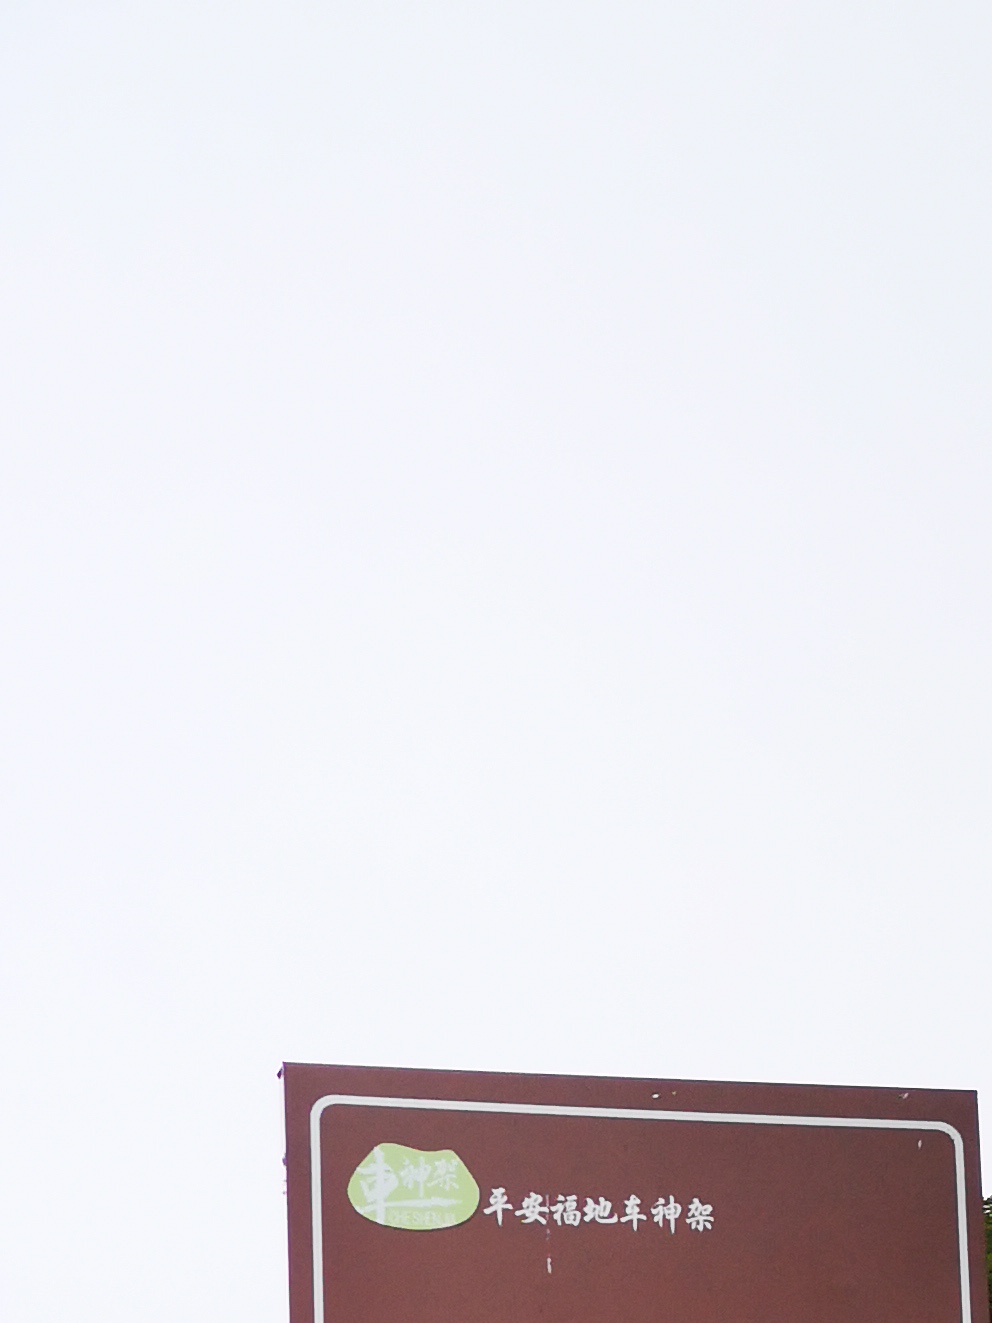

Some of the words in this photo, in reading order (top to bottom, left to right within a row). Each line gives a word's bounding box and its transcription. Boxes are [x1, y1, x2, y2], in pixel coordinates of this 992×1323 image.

[483, 1187, 715, 1234] 平安福地车神架
